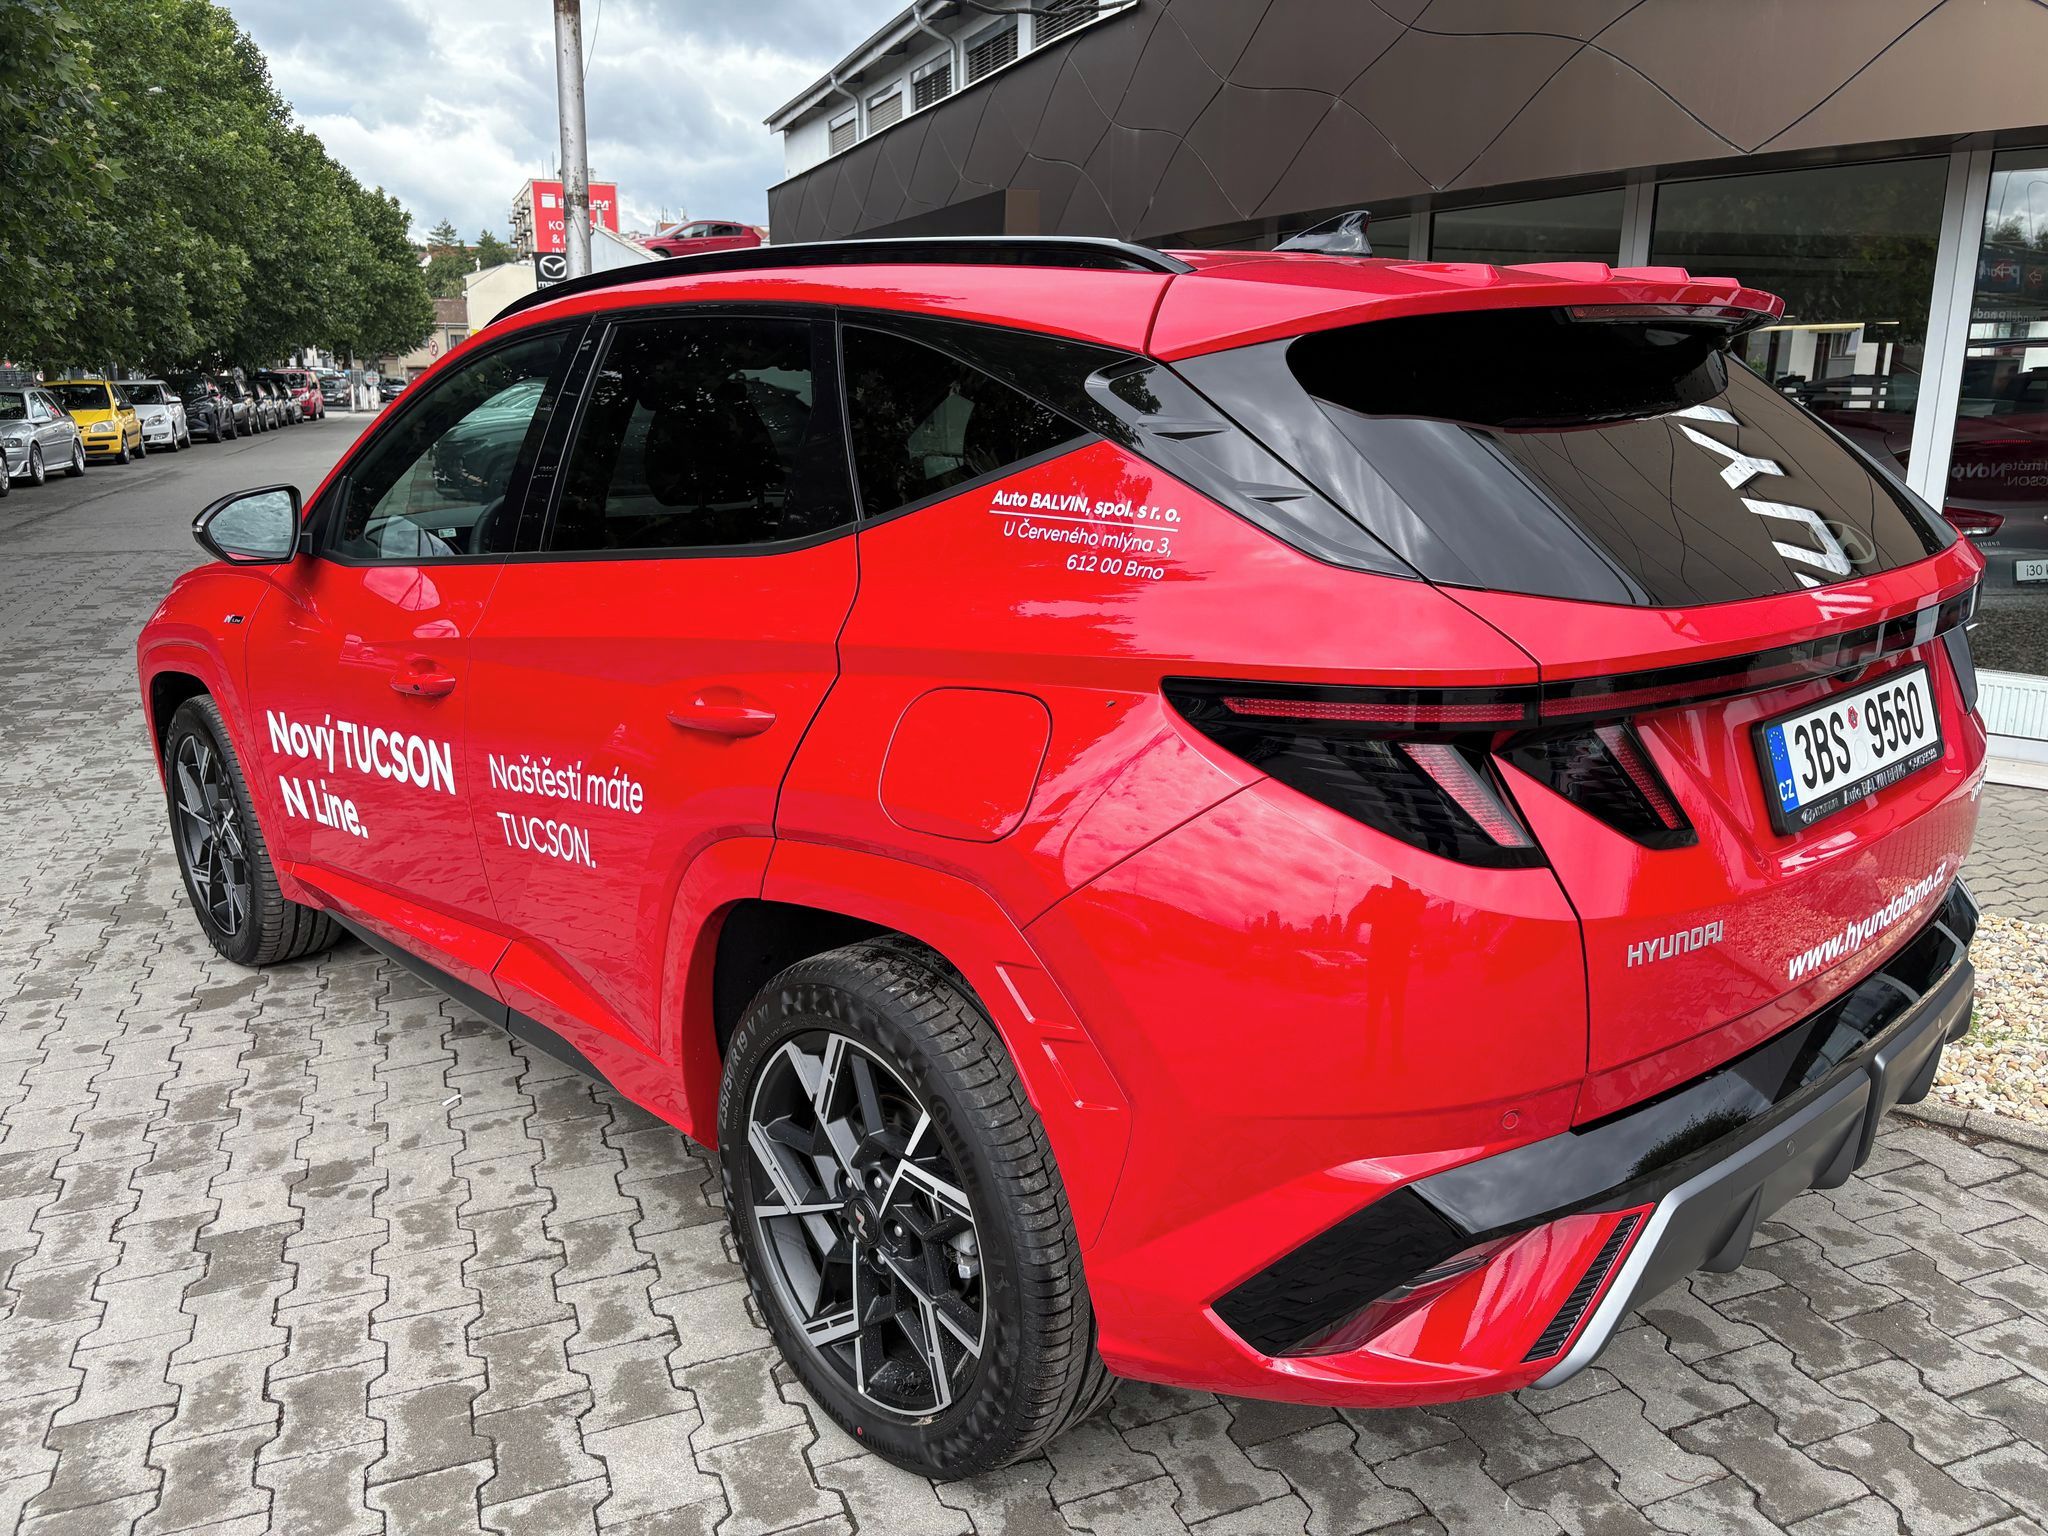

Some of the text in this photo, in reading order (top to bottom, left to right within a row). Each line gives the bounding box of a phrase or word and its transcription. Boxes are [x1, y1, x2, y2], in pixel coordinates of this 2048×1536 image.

[991, 490, 1181, 523] Auto BALVIN, spol. s r. o.
[1003, 518, 1172, 557] U Červeného mlýna 3,
[1066, 554, 1165, 580] 612 00 Brno
[2026, 564, 2043, 576] i30
[266, 709, 456, 795] Nový TUCSON
[1794, 681, 1924, 790] 3BS 9560
[278, 775, 369, 839] N Line.
[488, 753, 643, 814] Naštěstí máte
[1778, 778, 1795, 802] CZ
[496, 811, 597, 869] TUCSON.
[1627, 919, 1724, 968] HYUNDAI
[1787, 860, 1949, 981] www.hyundaibrno.cz
